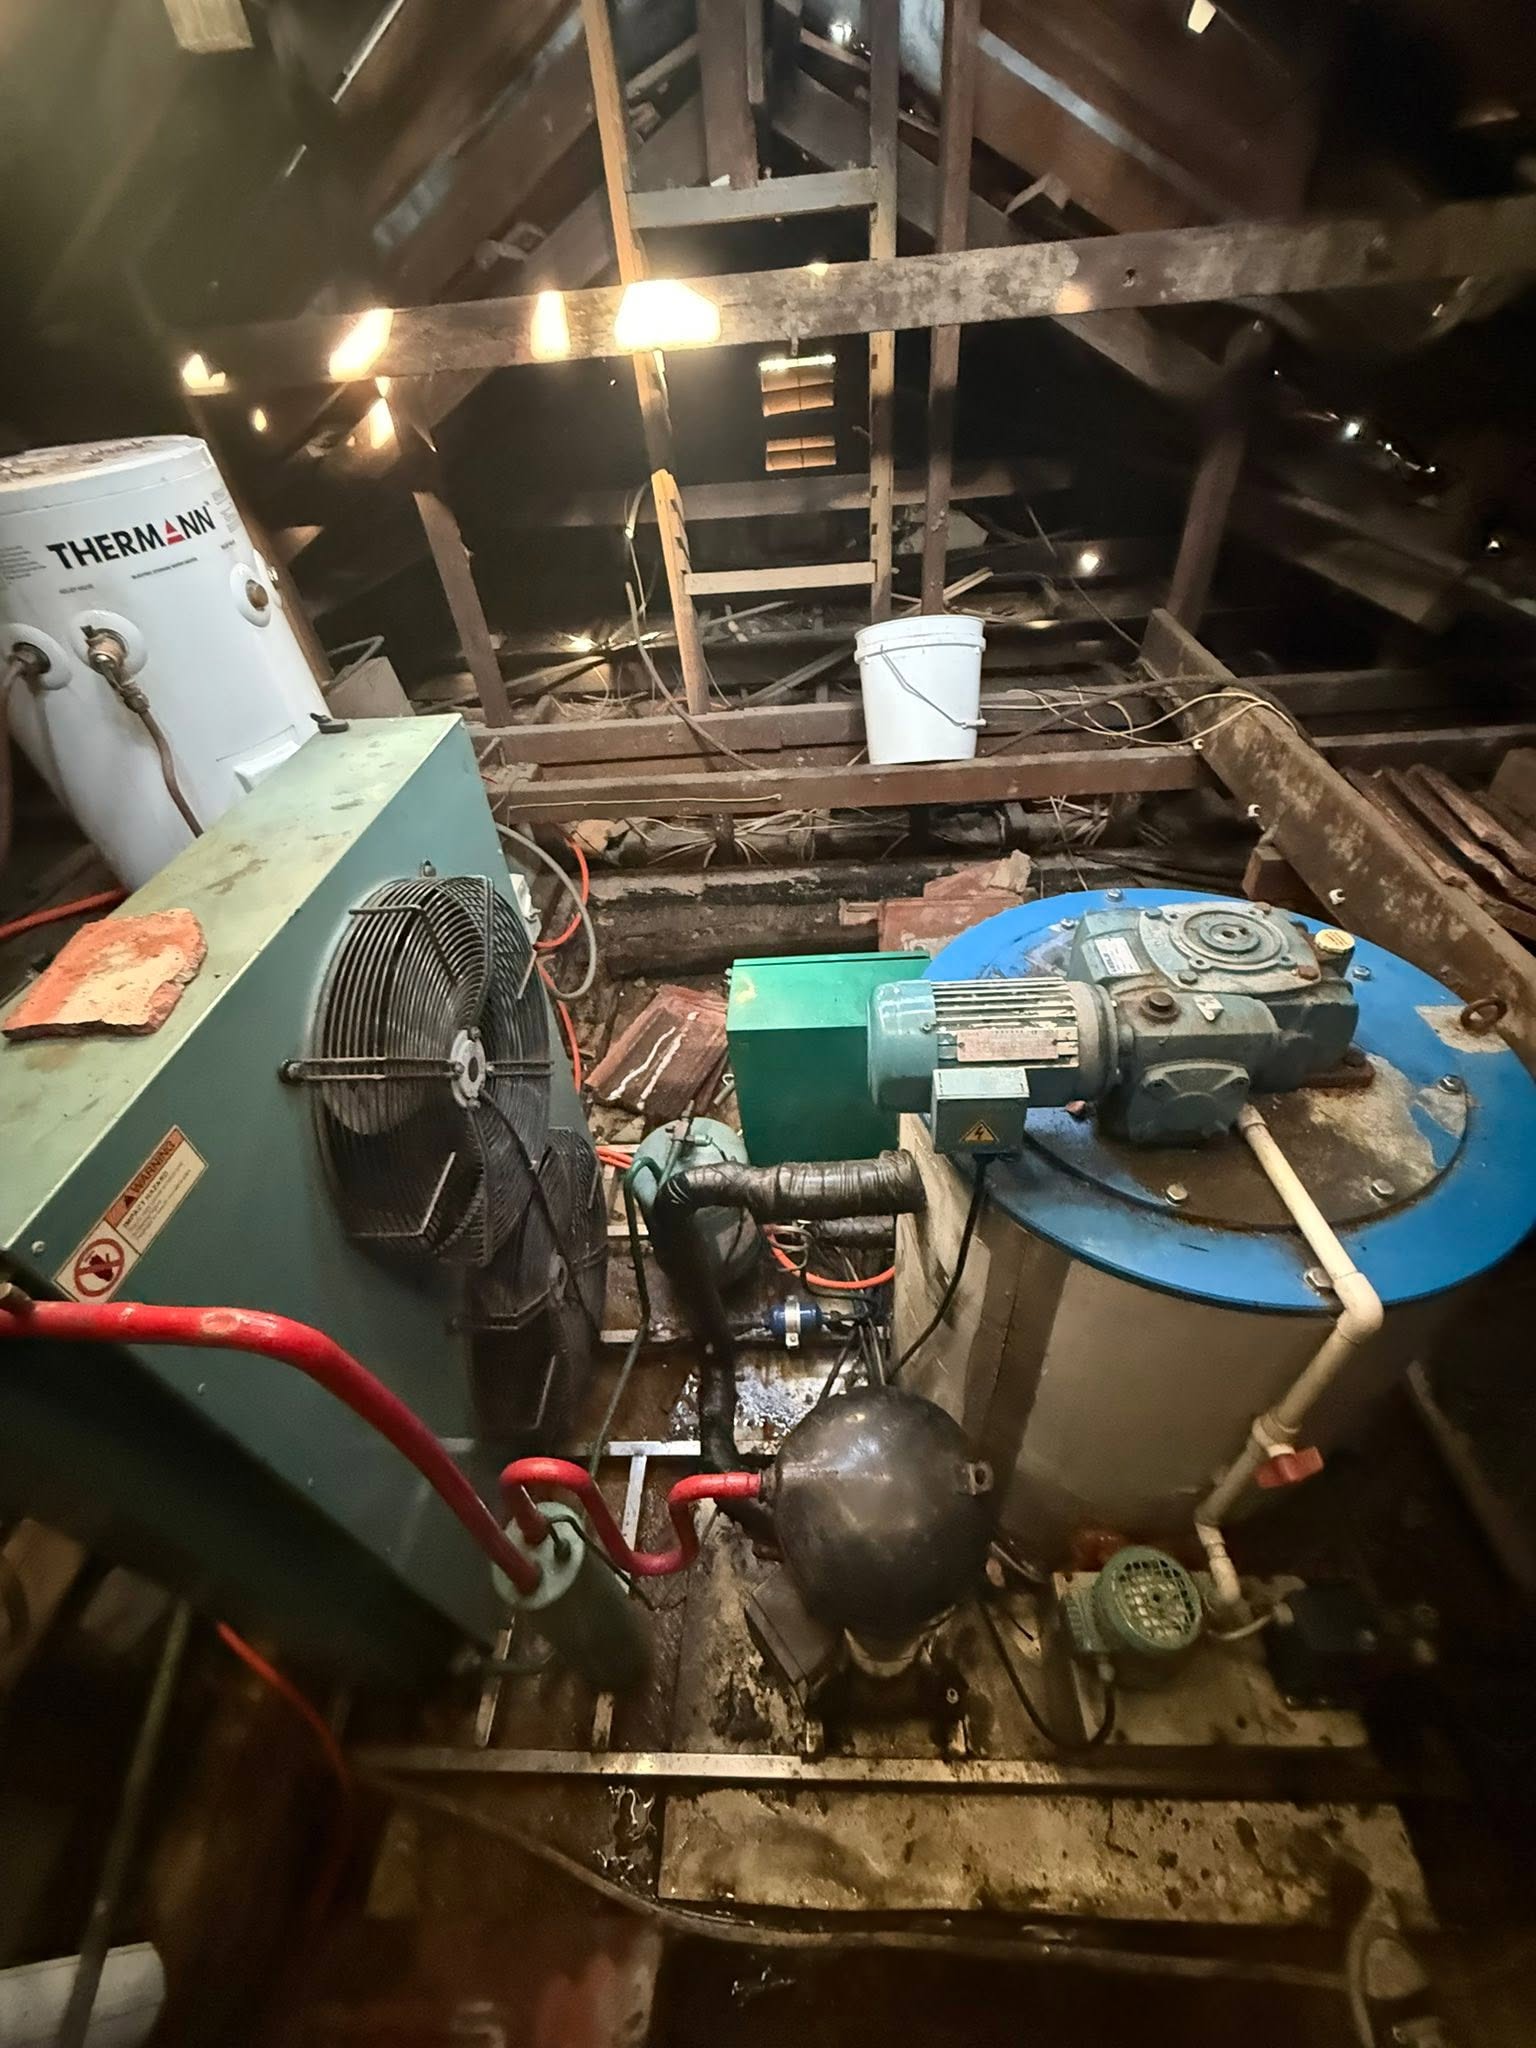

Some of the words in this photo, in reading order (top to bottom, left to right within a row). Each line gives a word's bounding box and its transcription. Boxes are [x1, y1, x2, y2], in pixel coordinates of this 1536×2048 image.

[46, 505, 216, 569] THERMANN
[131, 1140, 176, 1193] WARNING
[123, 1198, 146, 1228] IMPACT
[144, 1170, 169, 1200] HAZARD
